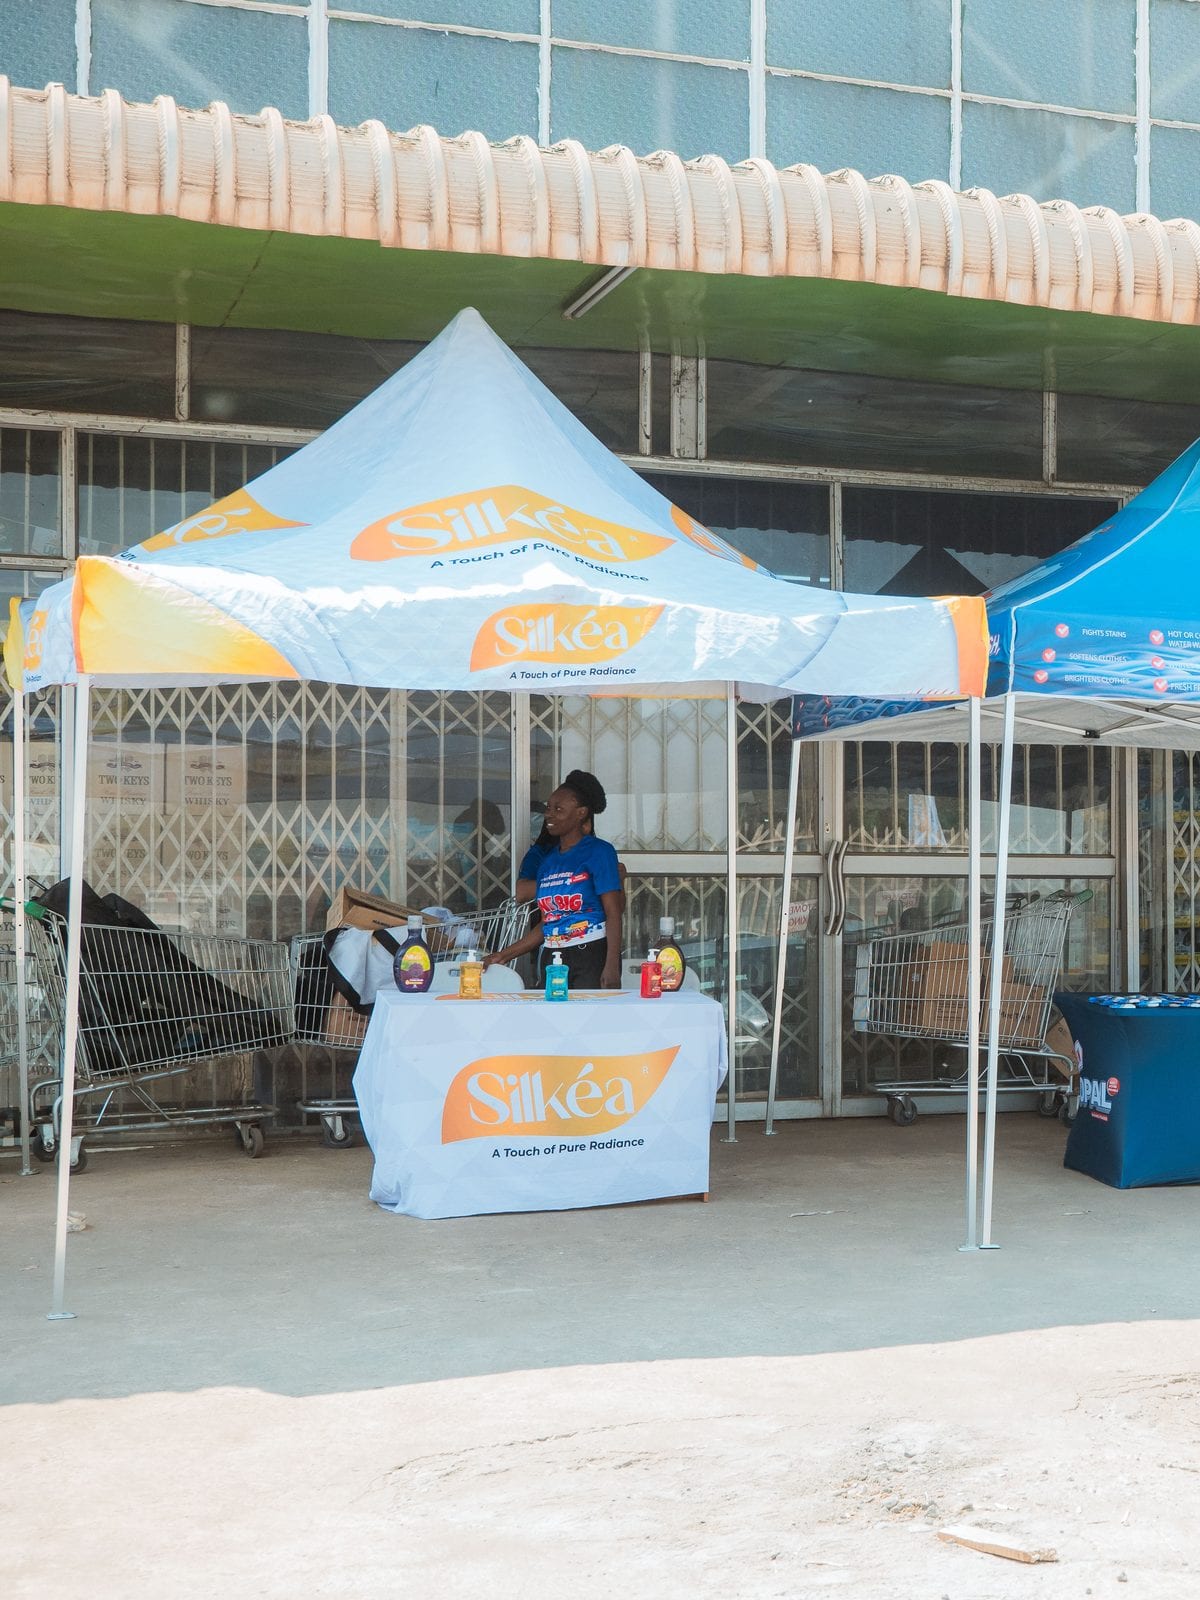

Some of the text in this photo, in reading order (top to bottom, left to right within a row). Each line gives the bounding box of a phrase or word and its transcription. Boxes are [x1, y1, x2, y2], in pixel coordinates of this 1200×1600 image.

[430, 543, 650, 582] A Touch of Pure Radiance
[494, 606, 630, 657] Silkéa
[1082, 629, 1127, 638] FIGHTS STAINS
[1168, 630, 1181, 638] HOT
[1184, 631, 1194, 639] OR
[1168, 640, 1192, 648] WATER
[1069, 653, 1097, 662] SOFTENS
[520, 671, 548, 679] Touch
[550, 670, 562, 678] of
[563, 668, 587, 677] Pure
[589, 666, 637, 676] Radiance
[1064, 674, 1100, 684] BRIGHTENS
[1170, 683, 1193, 691] FRESH
[123, 776, 150, 786] KEYS
[466, 1062, 635, 1126] Silkéa
[491, 1138, 644, 1158] A Touch of Pure Radiance
